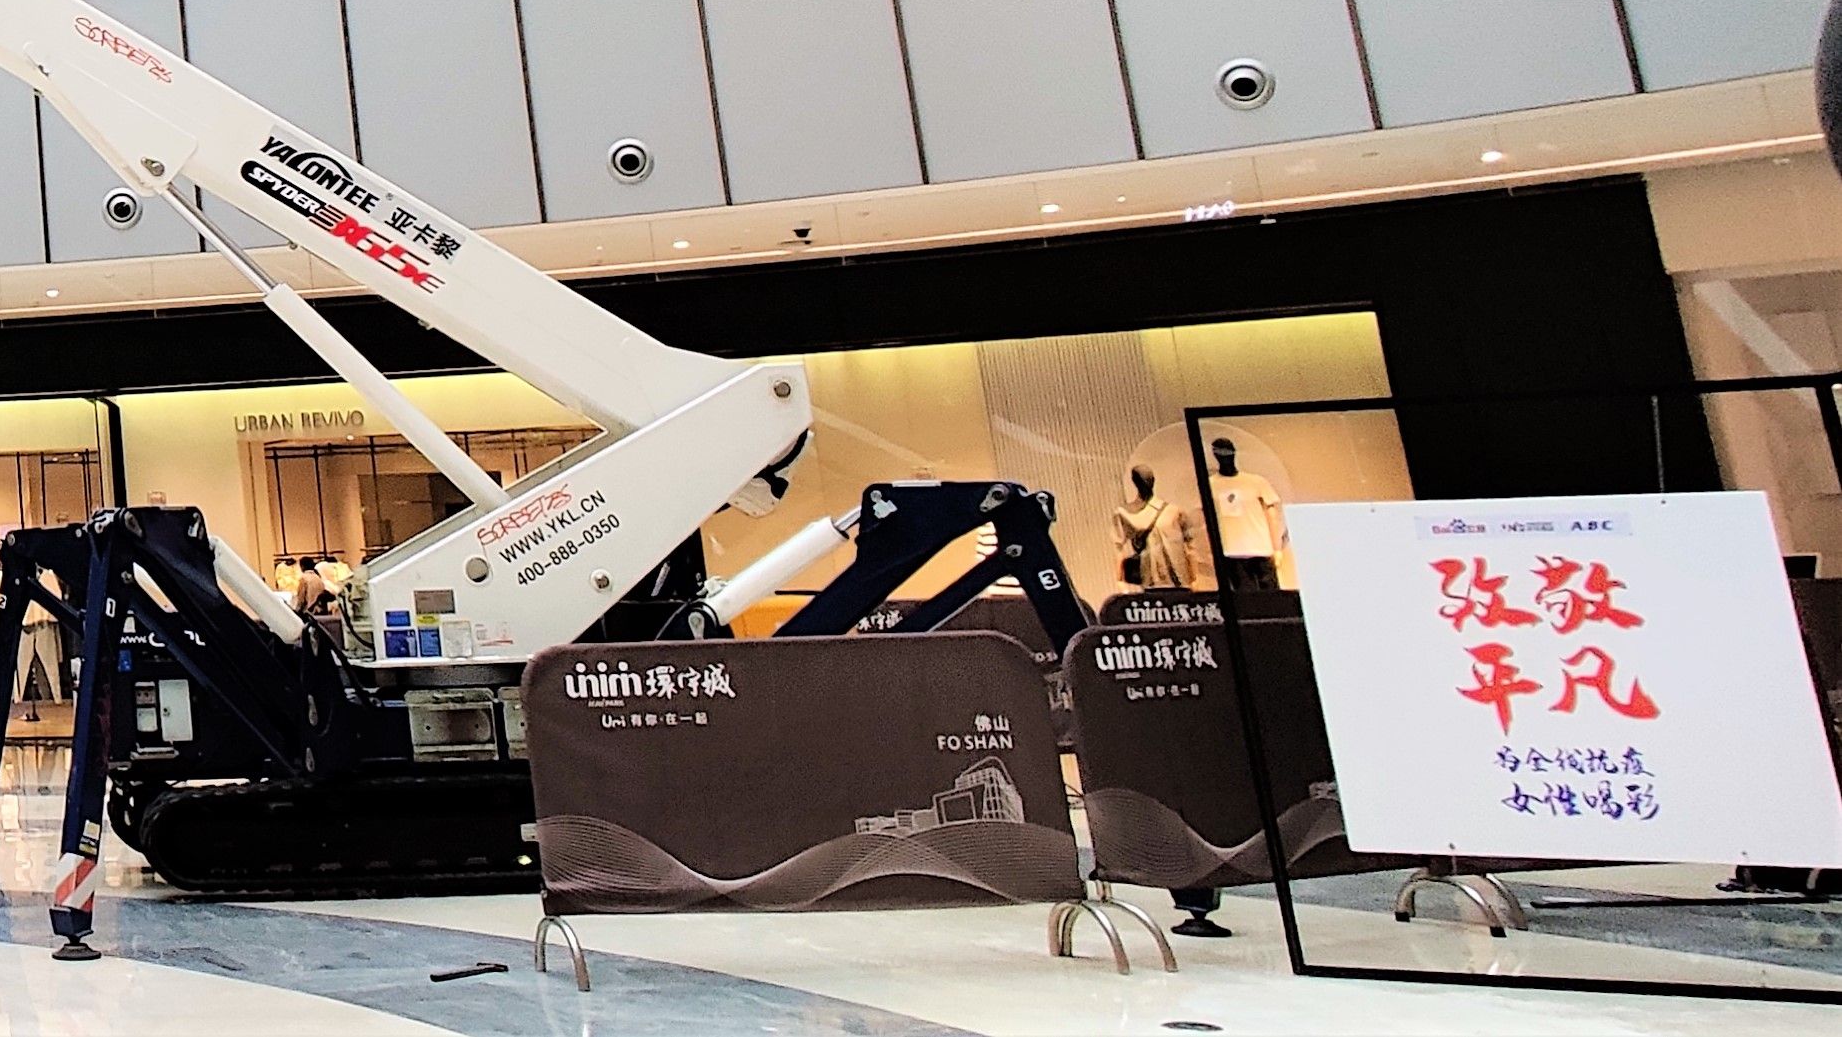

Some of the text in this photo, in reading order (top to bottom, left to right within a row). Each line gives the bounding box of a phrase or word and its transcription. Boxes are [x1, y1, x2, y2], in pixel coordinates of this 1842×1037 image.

[248, 166, 323, 214] SPYDER
[384, 206, 462, 261] 亚卡黎
[234, 410, 365, 432] URBAN REVIVO
[499, 490, 606, 563] WWW.YKL.CN
[517, 514, 621, 587] 400-888-0350
[1042, 571, 1057, 587] 3
[1429, 556, 1645, 634] 致敬
[1455, 643, 1661, 737] 平凡
[937, 734, 1014, 751] FO SHAN
[974, 714, 1010, 732] 佛山
[1501, 780, 1660, 821] 女性喝彩
